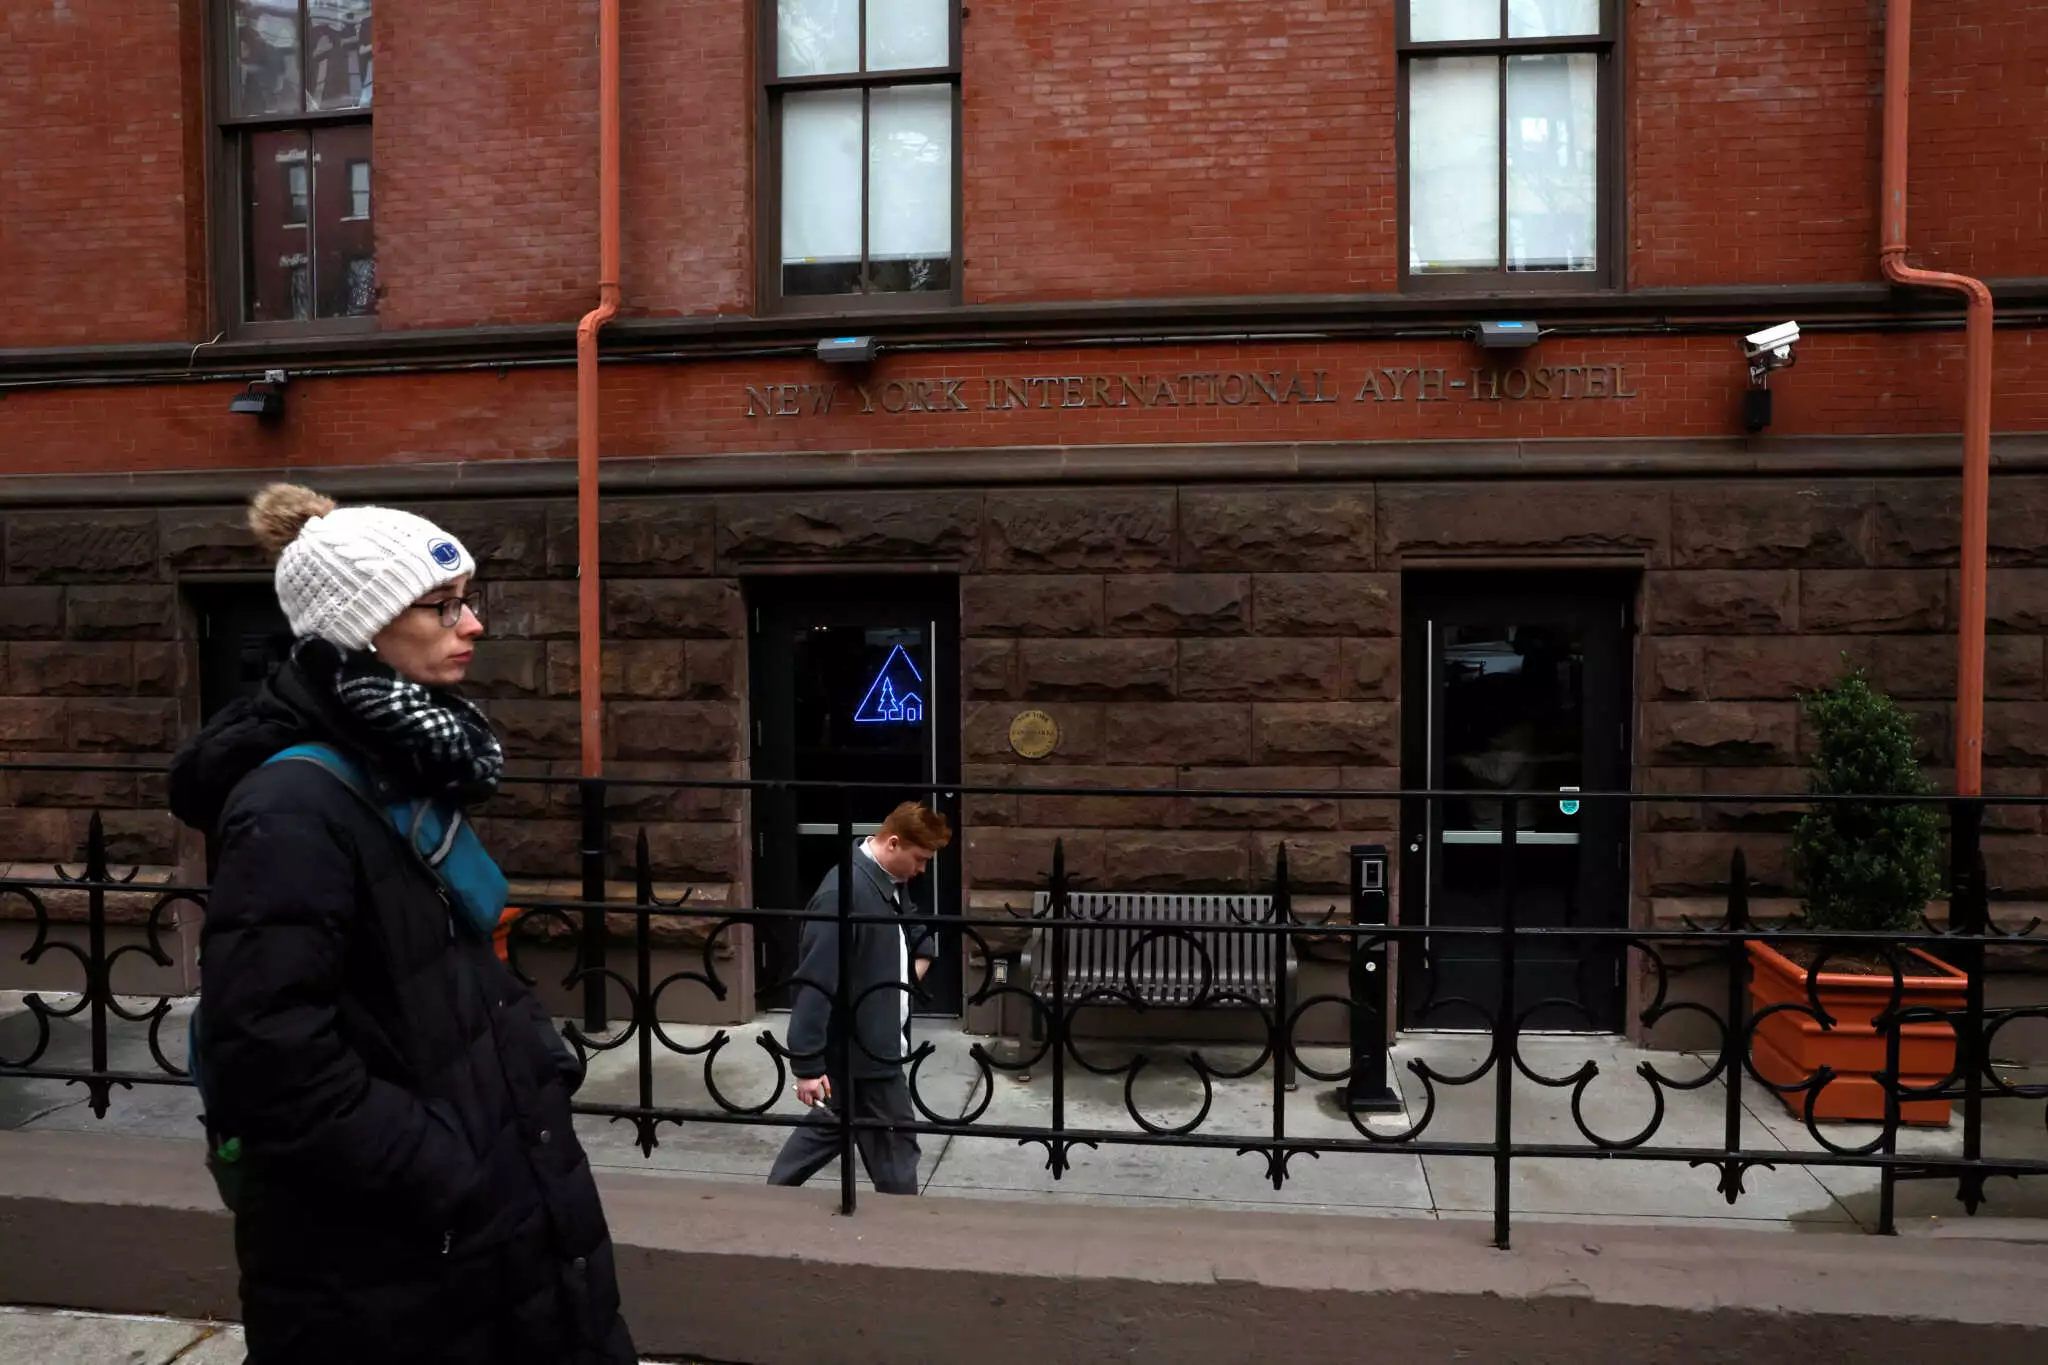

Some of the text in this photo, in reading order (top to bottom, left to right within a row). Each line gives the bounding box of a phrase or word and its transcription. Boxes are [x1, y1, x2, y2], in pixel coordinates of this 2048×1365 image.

[745, 364, 1638, 416] NEW YORK INTERNATIONAL AYH-HOSTEL
